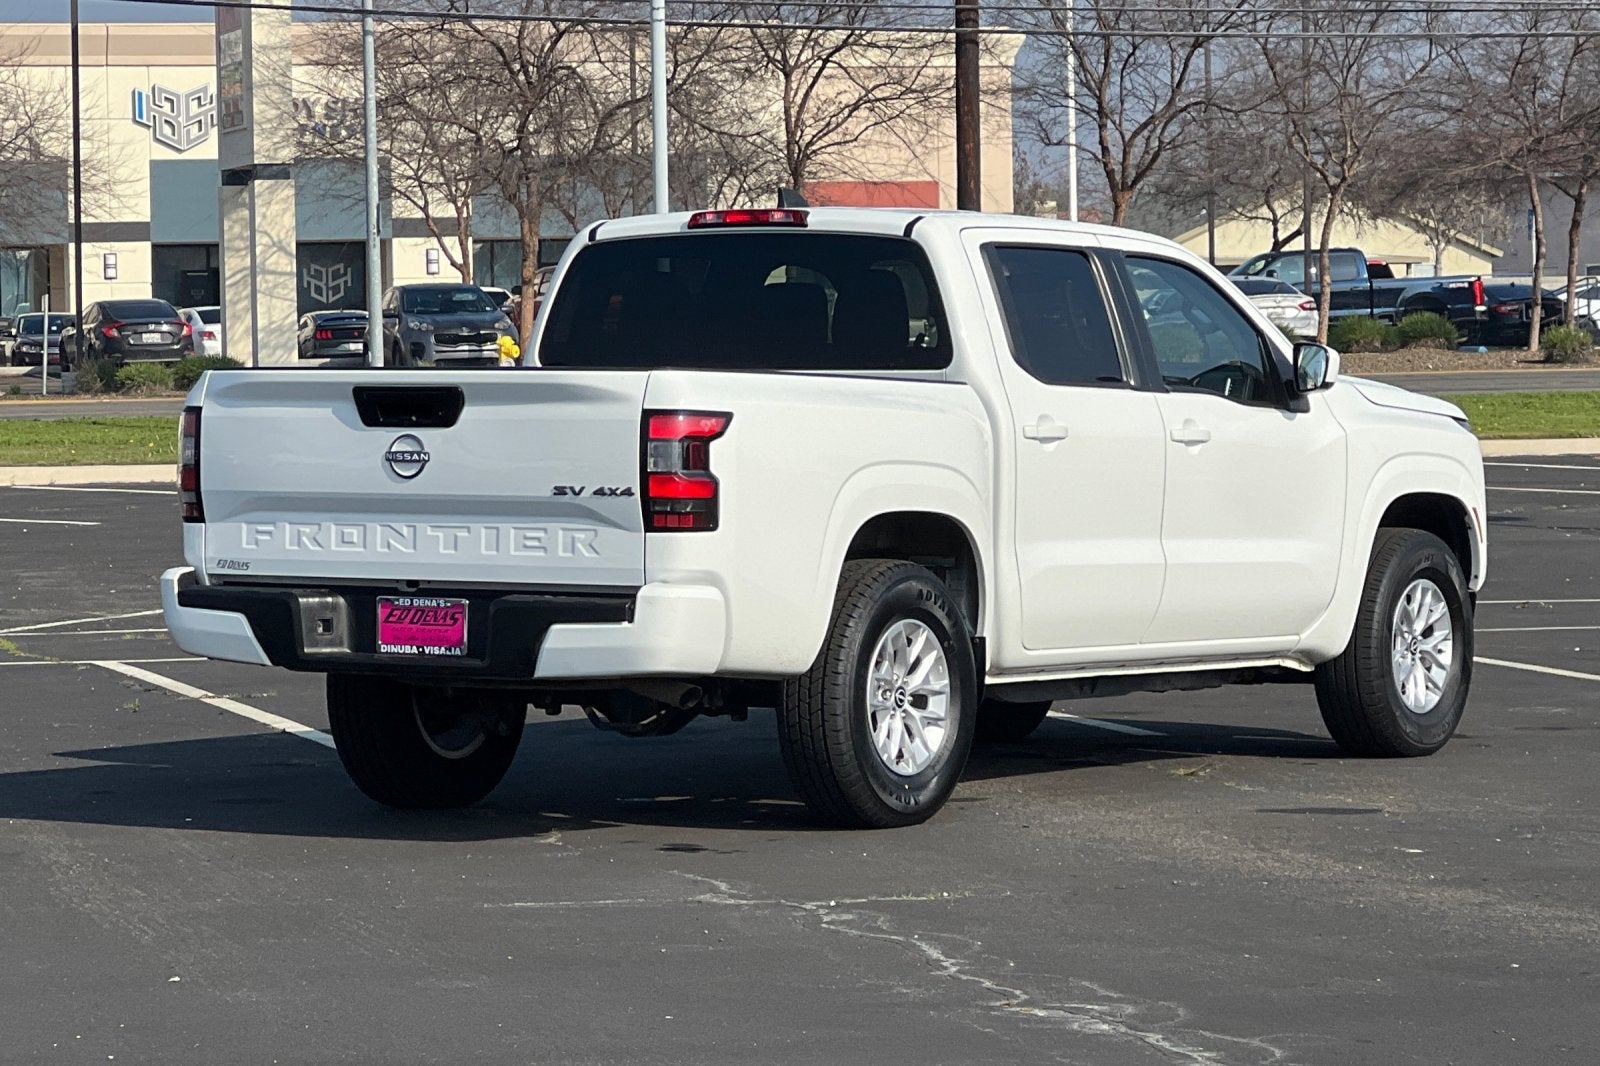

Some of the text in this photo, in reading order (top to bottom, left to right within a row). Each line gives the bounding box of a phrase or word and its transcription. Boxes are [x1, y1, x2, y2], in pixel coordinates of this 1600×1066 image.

[386, 452, 429, 461] NISSAN
[553, 485, 585, 496] SV
[240, 521, 602, 559] FRONTIER
[399, 598, 446, 607] ED DENA'S
[383, 608, 411, 624] ED
[380, 644, 418, 654] DINUBA
